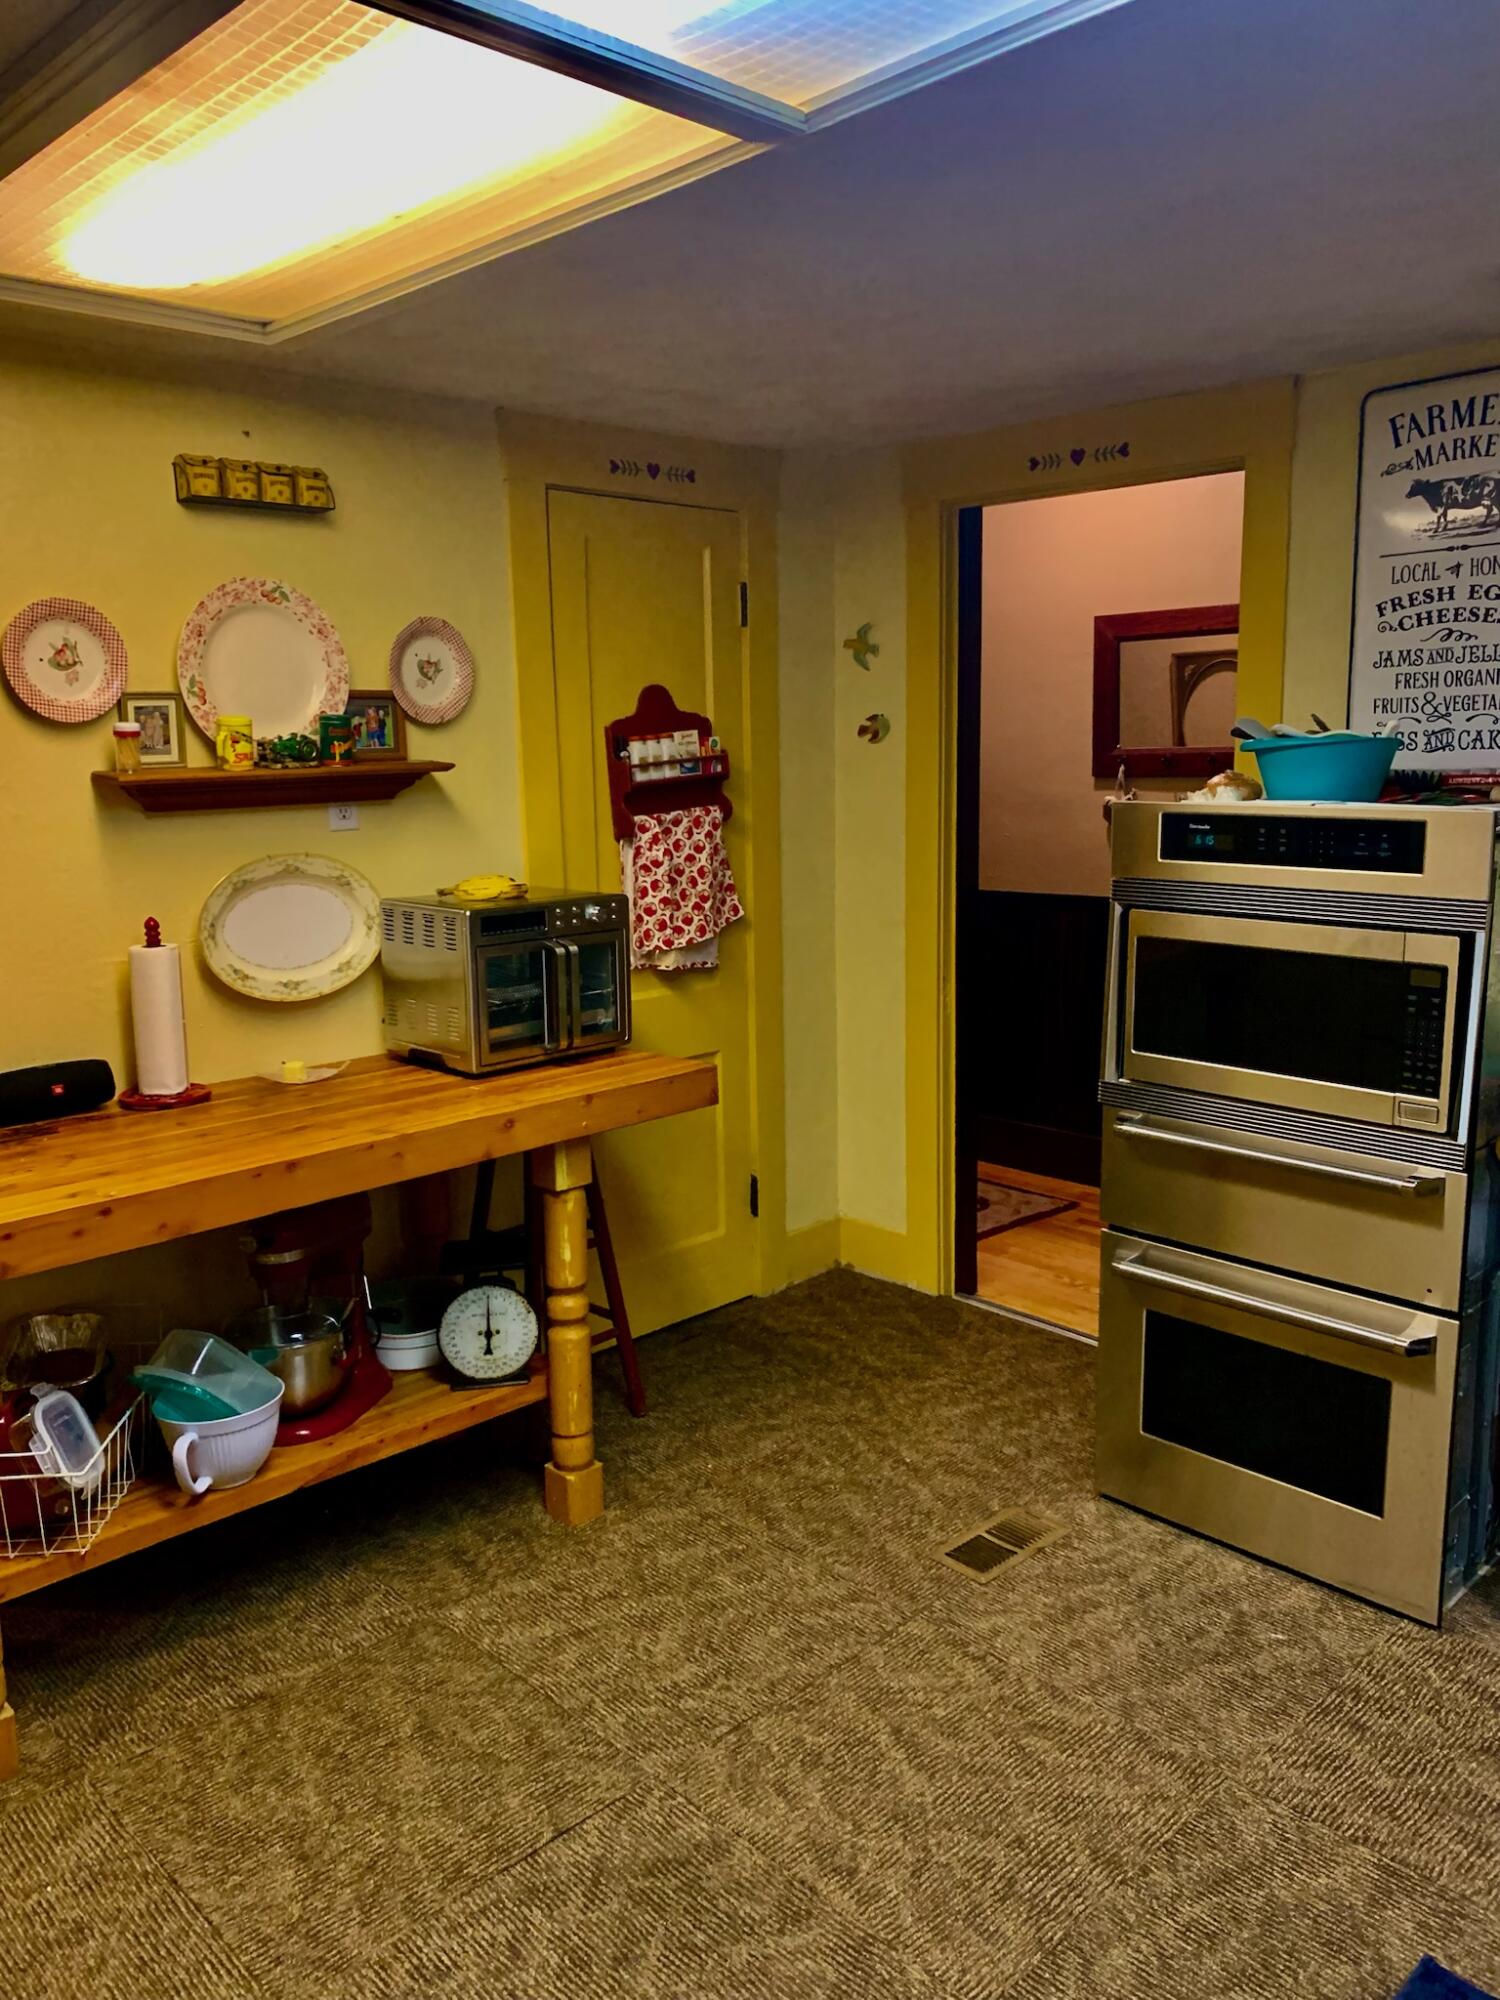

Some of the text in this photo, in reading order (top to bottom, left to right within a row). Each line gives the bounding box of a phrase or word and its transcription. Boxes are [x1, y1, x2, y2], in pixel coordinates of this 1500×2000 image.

[1388, 393, 1500, 450] FARME
[1391, 561, 1441, 585] LOCAL
[1376, 585, 1456, 618] FRESH
[1397, 606, 1500, 632] CHEESE
[1372, 648, 1424, 669] JAMS
[1426, 646, 1454, 665] AND
[1394, 670, 1439, 690] FRESH
[1373, 691, 1500, 722] FRUITS & VEGETA
[1421, 727, 1456, 754] AND
